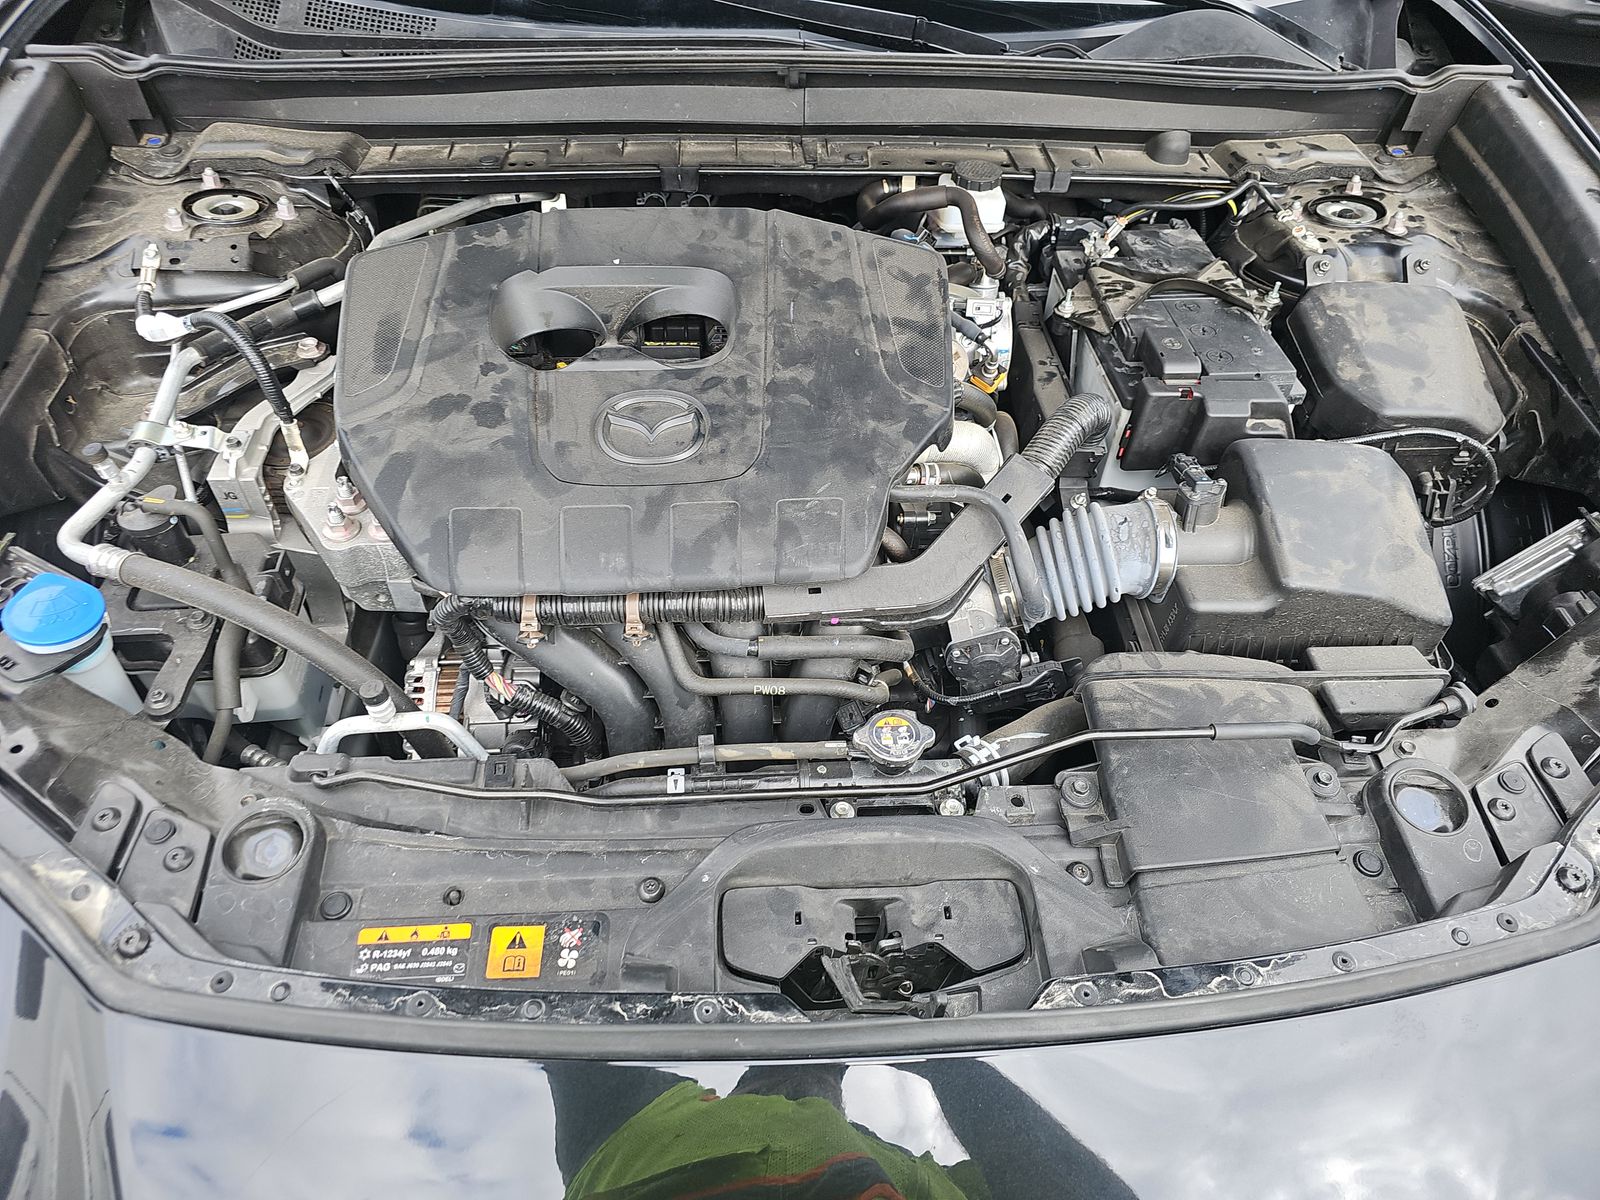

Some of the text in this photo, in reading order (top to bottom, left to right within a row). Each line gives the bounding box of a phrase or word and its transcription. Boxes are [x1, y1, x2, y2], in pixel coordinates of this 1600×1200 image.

[223, 491, 238, 500] JG
[753, 684, 786, 696] PW08
[446, 946, 458, 957] kg
[370, 963, 391, 972] PAG
